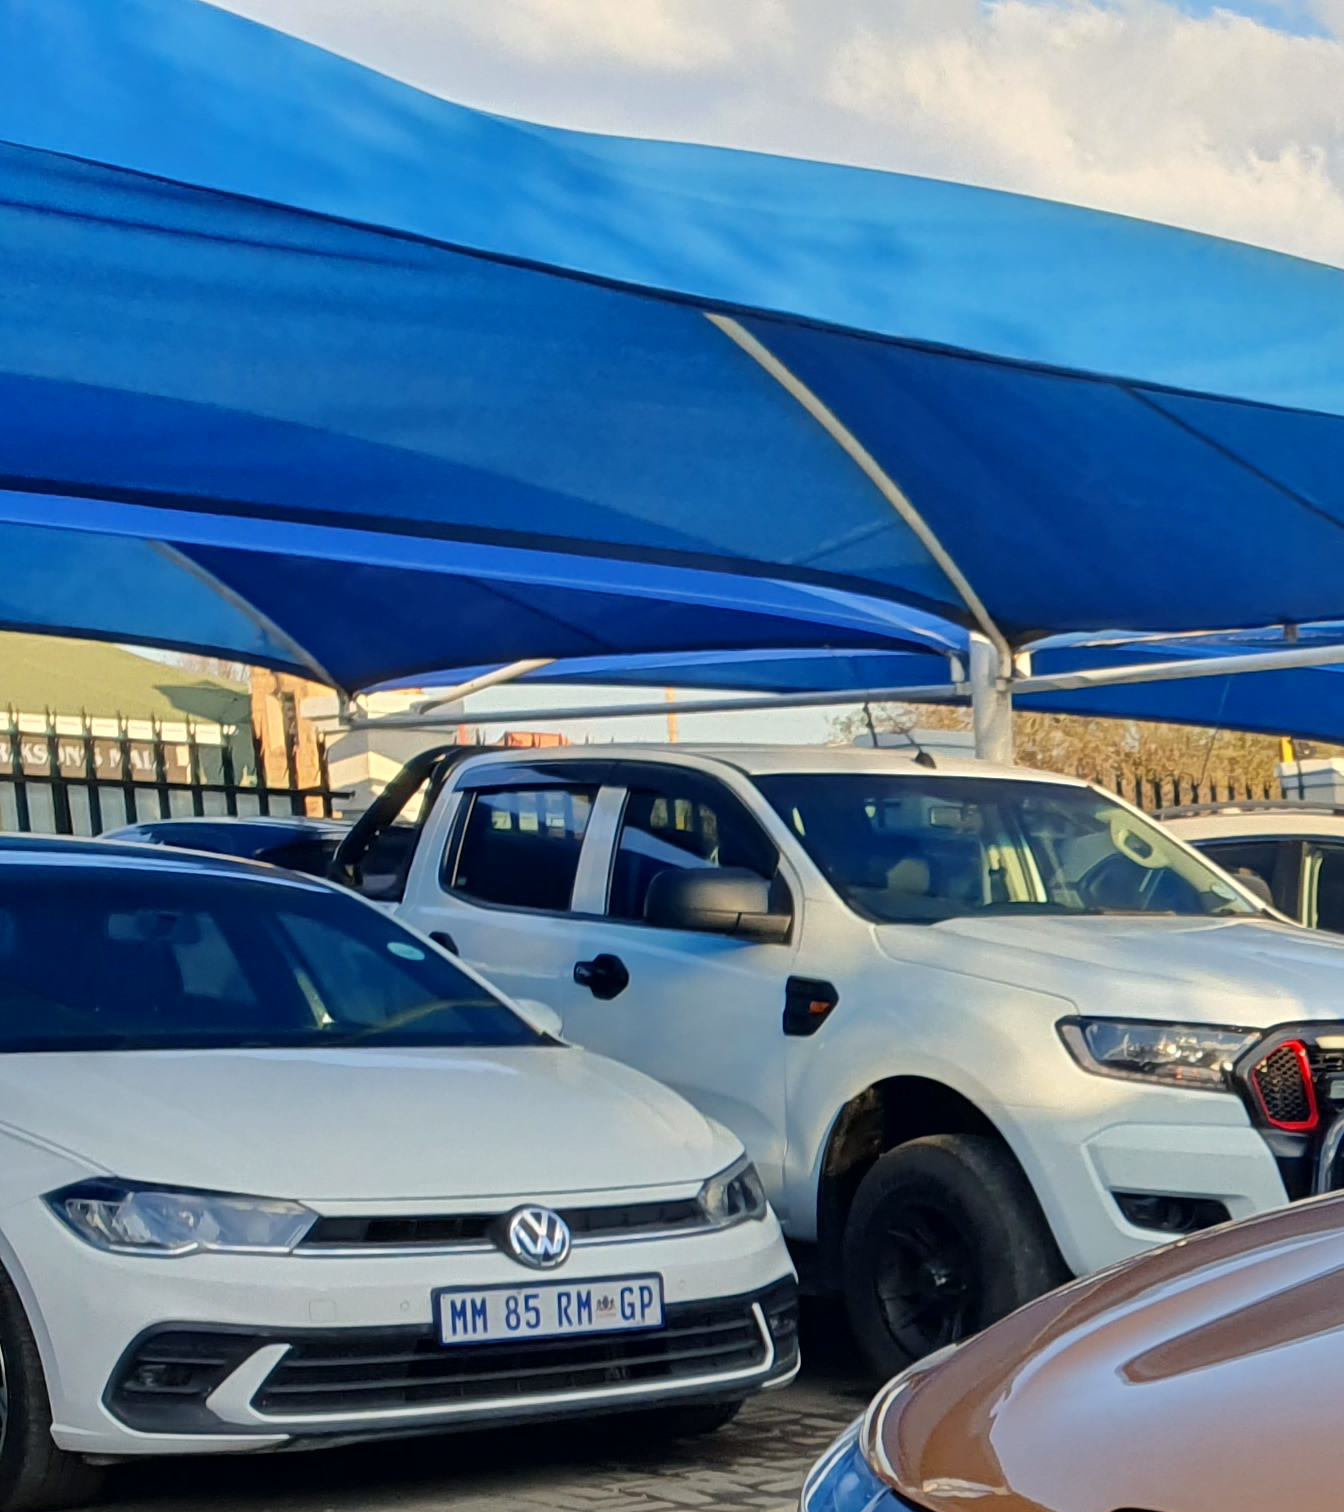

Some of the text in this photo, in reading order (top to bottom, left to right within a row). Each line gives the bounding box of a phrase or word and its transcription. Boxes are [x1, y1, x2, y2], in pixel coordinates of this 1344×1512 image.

[450, 1285, 653, 1336] MM 85 RM GP
